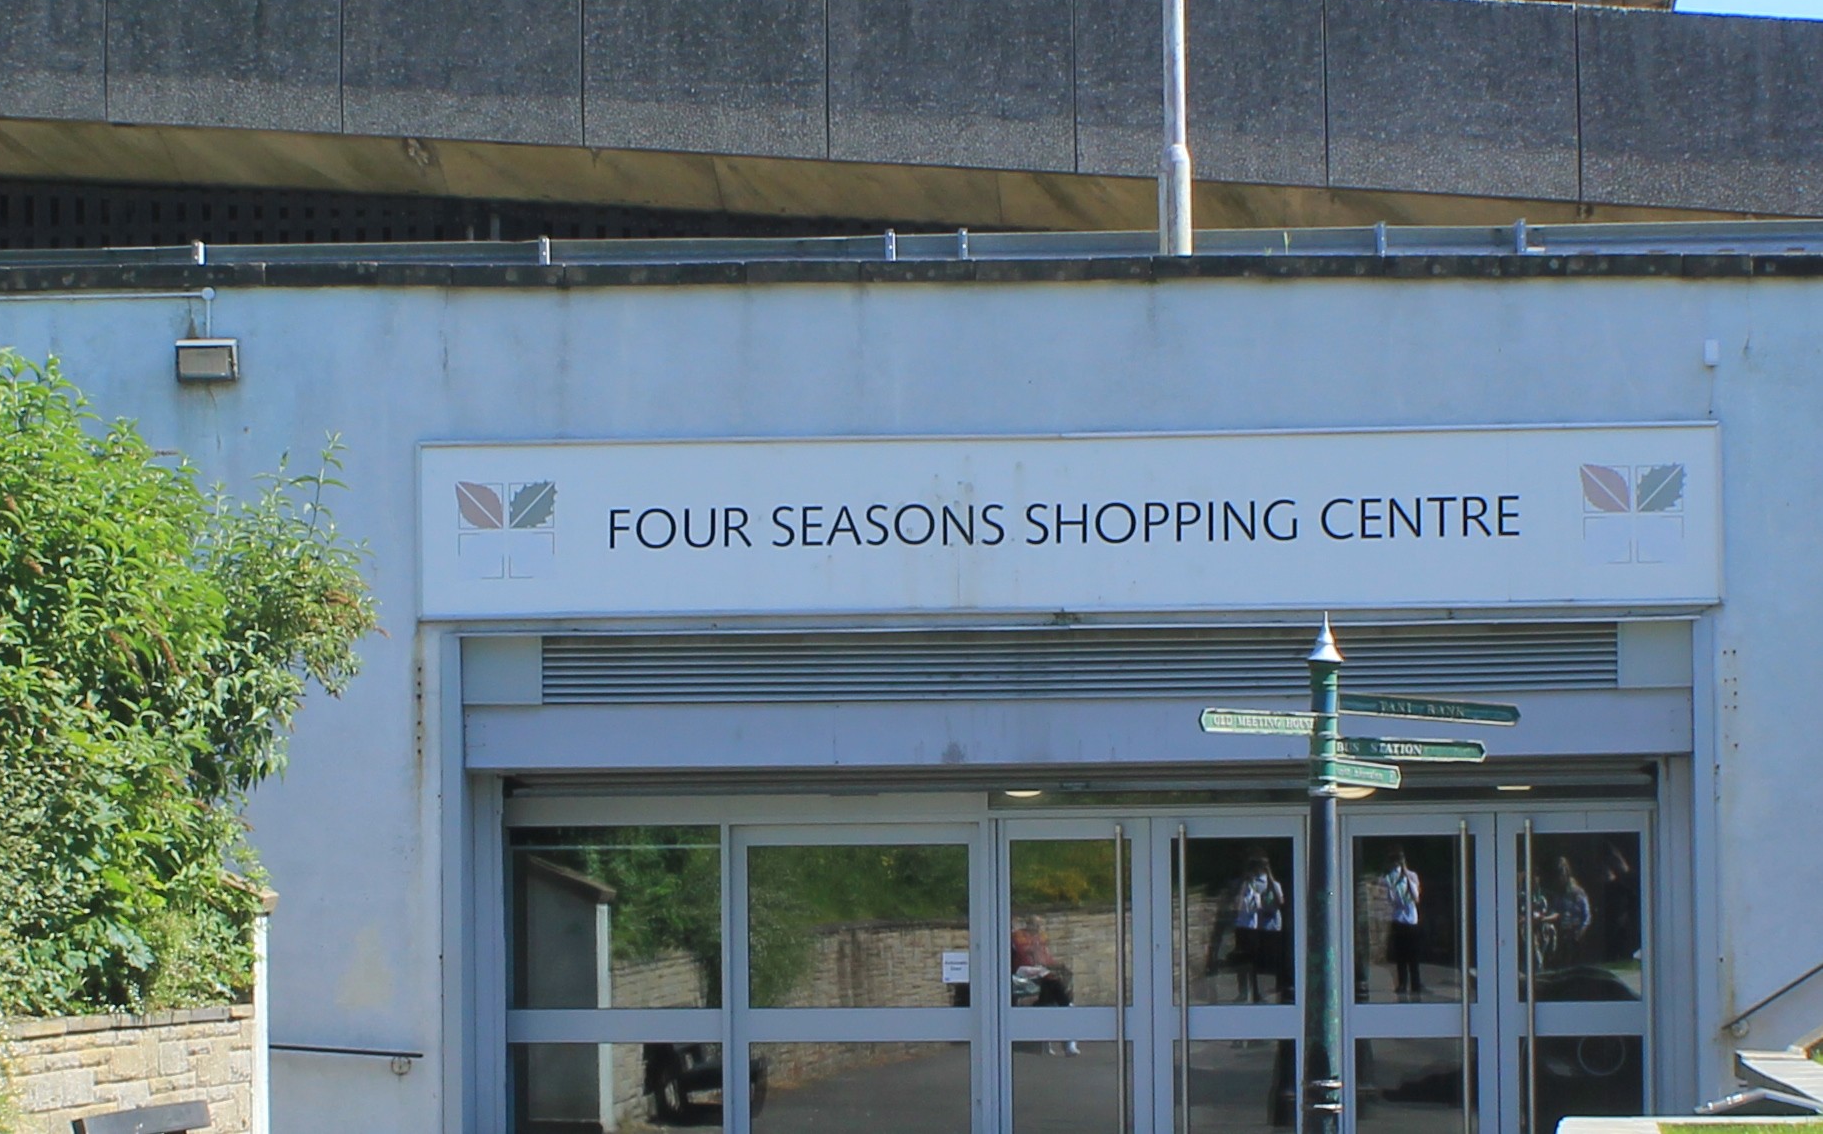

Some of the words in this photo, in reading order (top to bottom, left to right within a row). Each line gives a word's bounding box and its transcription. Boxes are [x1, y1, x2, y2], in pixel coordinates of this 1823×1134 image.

[607, 507, 753, 550] FOUR
[771, 503, 1006, 548] SEASONS
[1024, 498, 1300, 545] SHOPPING
[1320, 495, 1521, 540] CENTRE
[1379, 700, 1412, 714] TAXI
[1427, 703, 1465, 717] RANK
[1213, 715, 1233, 726] OLD
[1236, 715, 1282, 729] MEETING
[1336, 741, 1360, 753] BUS
[1370, 742, 1423, 755] STATION
